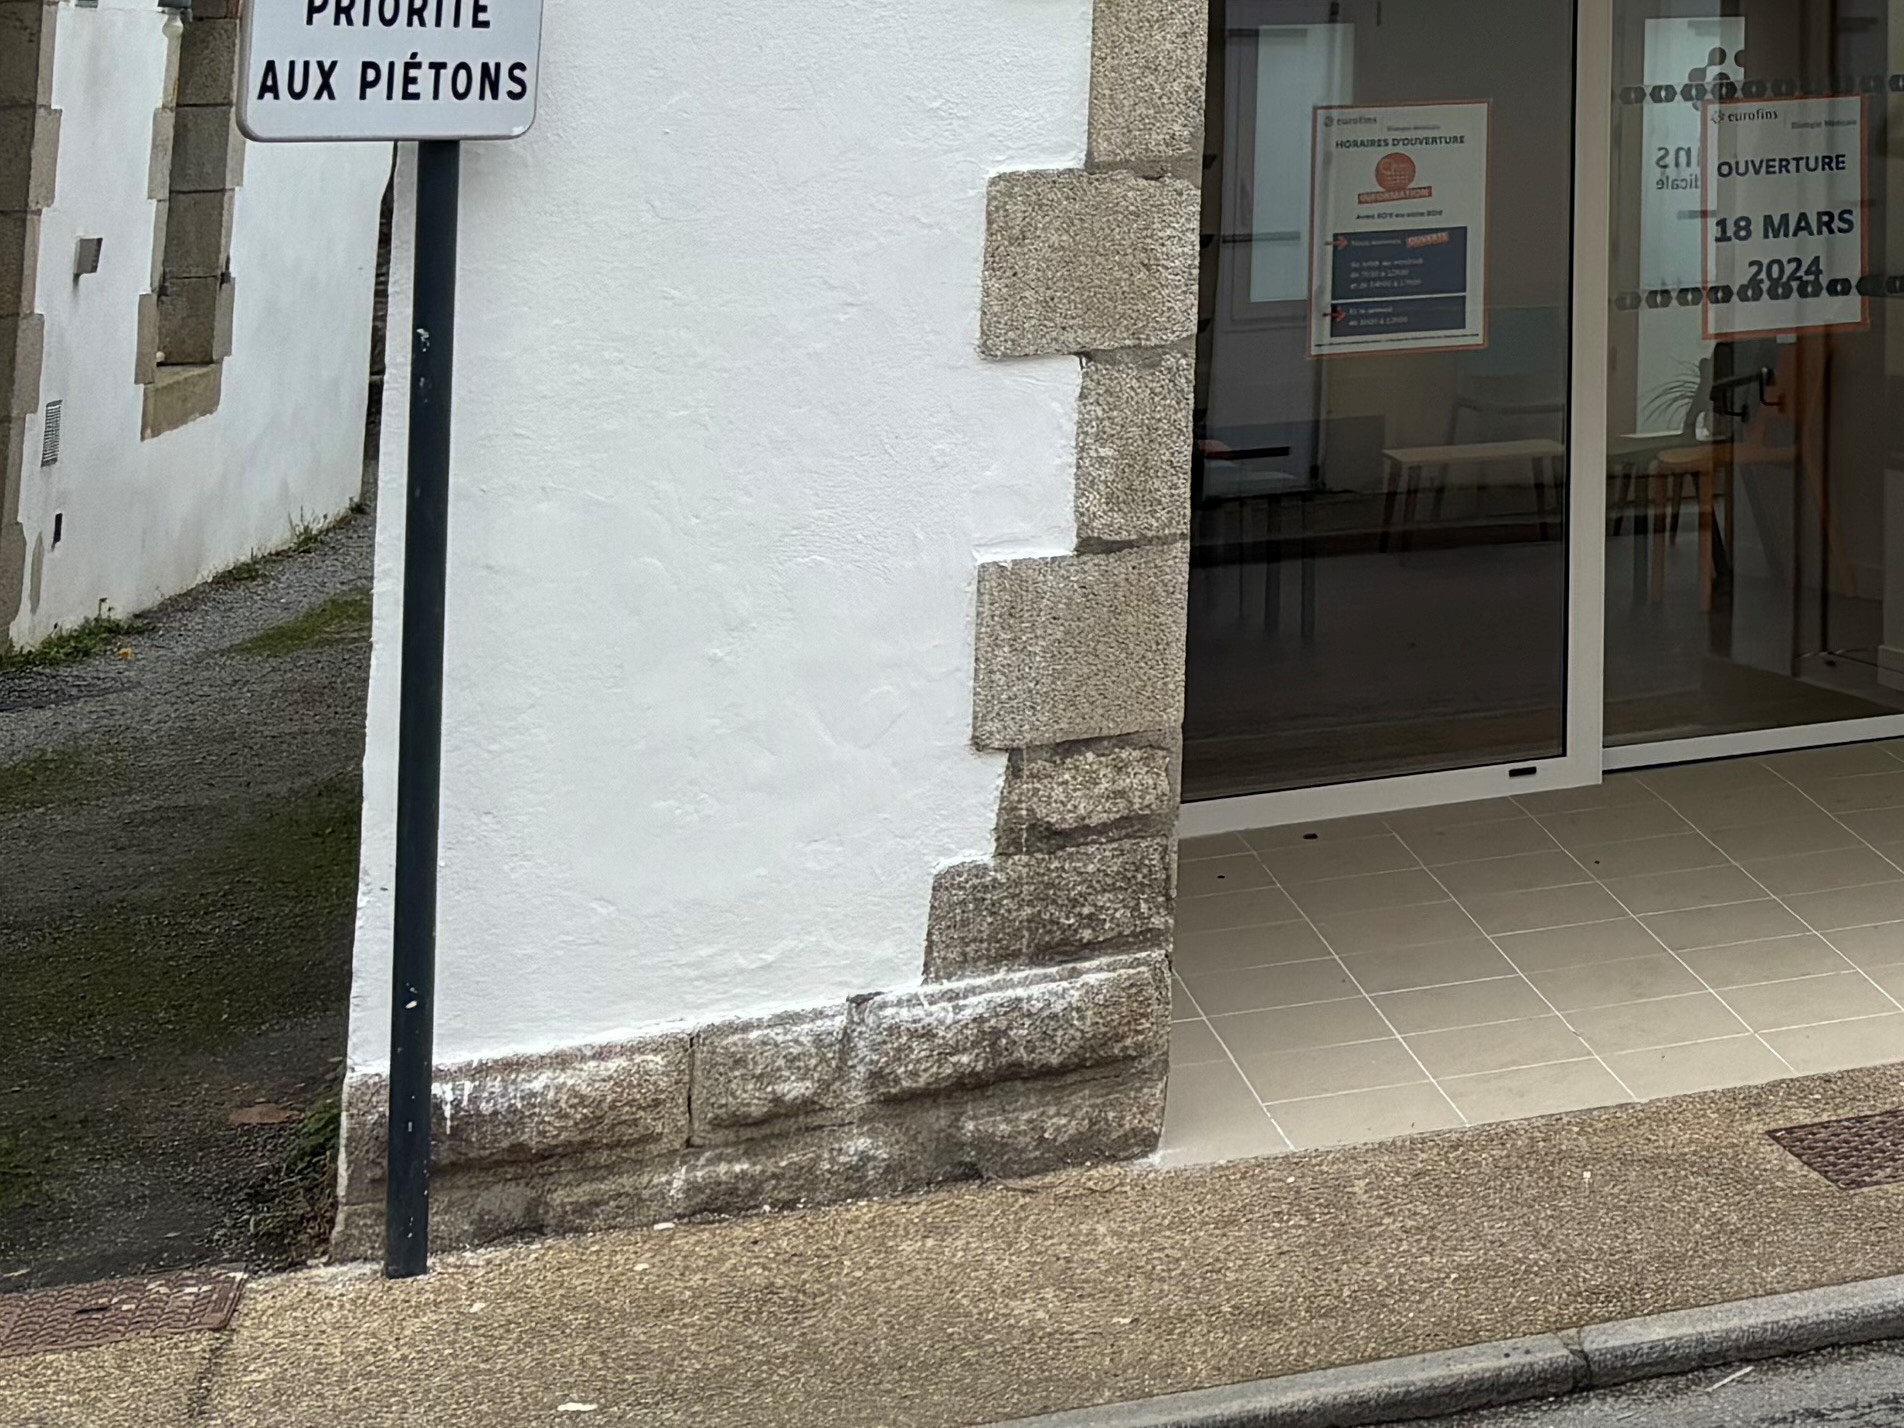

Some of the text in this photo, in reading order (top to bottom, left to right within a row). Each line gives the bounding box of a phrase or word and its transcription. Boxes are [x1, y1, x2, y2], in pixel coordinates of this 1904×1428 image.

[257, 48, 529, 102] AUX PIÉTONS
[1727, 108, 1779, 123] eurofins
[1335, 138, 1390, 150] HORAIRES
[1717, 153, 1847, 179] OUVERTURE
[1714, 209, 1855, 243] 18 MARS
[1748, 255, 1823, 287] 2024
